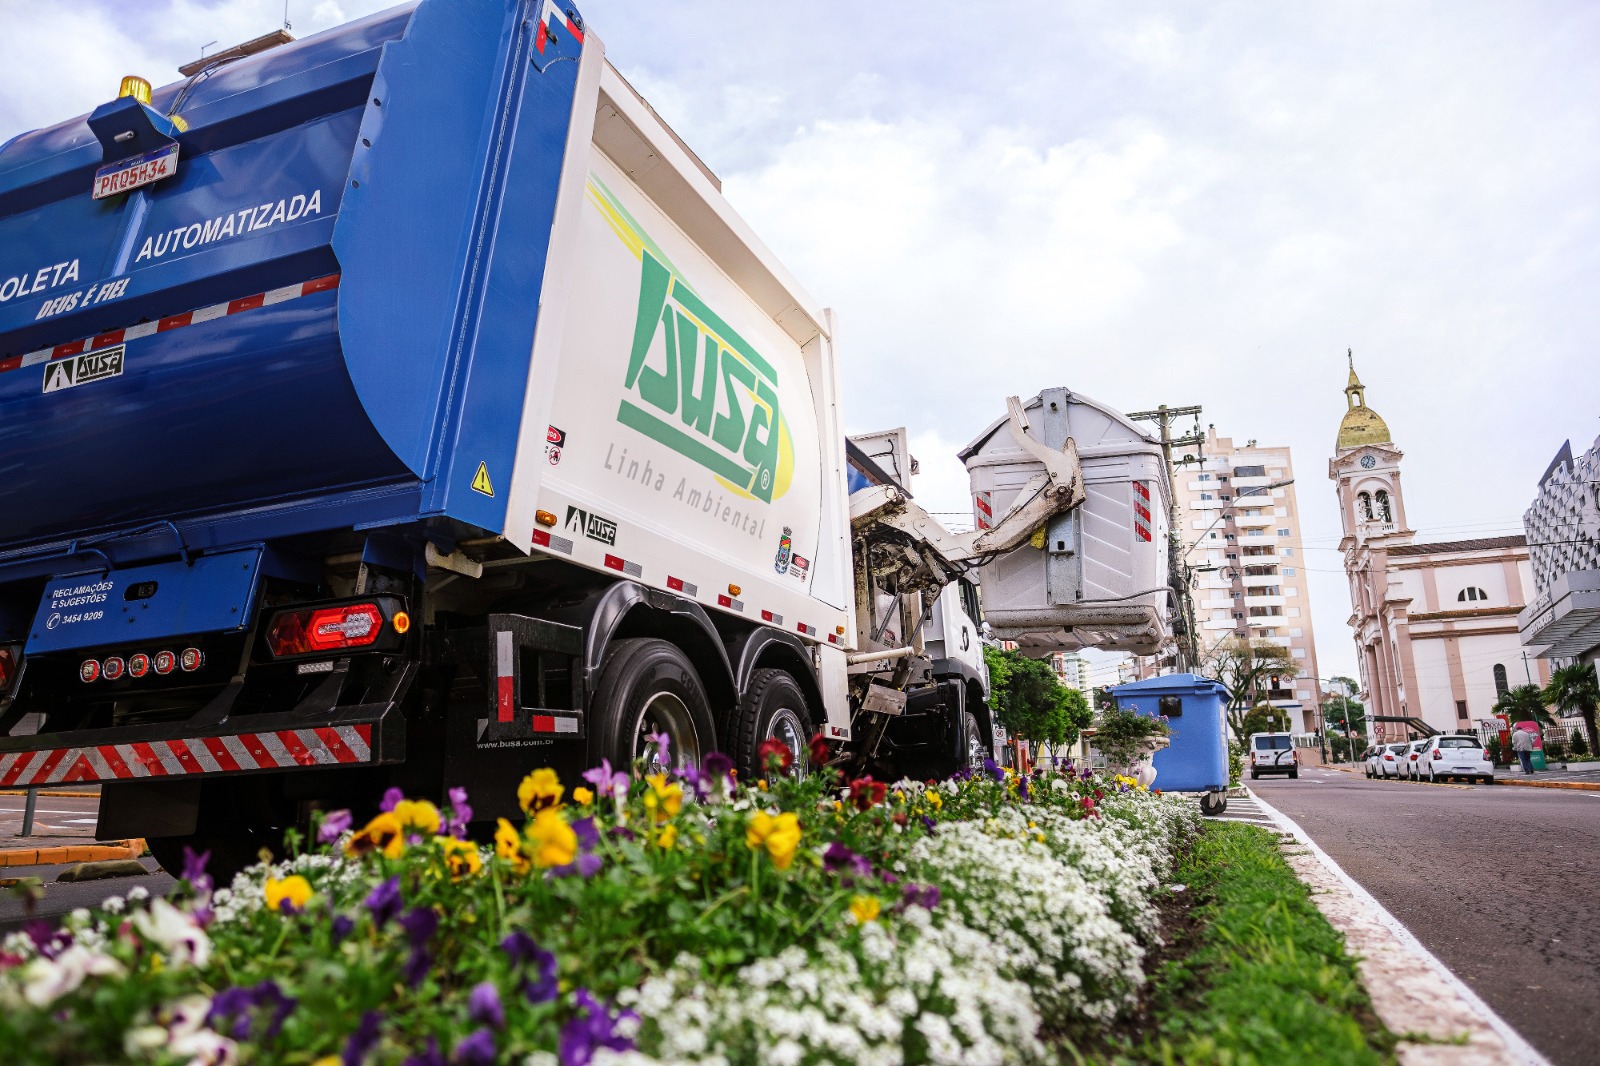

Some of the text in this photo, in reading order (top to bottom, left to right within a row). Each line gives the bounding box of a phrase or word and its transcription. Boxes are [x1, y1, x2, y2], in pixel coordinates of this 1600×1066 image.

[0, 190, 321, 302] OLETA AUTOMATIZADA
[35, 278, 131, 320] DEUS É FIEL
[604, 443, 766, 540] Linha Ambiental
[51, 593, 107, 609] E SUGESTÕES
[53, 581, 114, 598] RECLAMAÇÕES
[62, 611, 104, 624] 3454 9209
